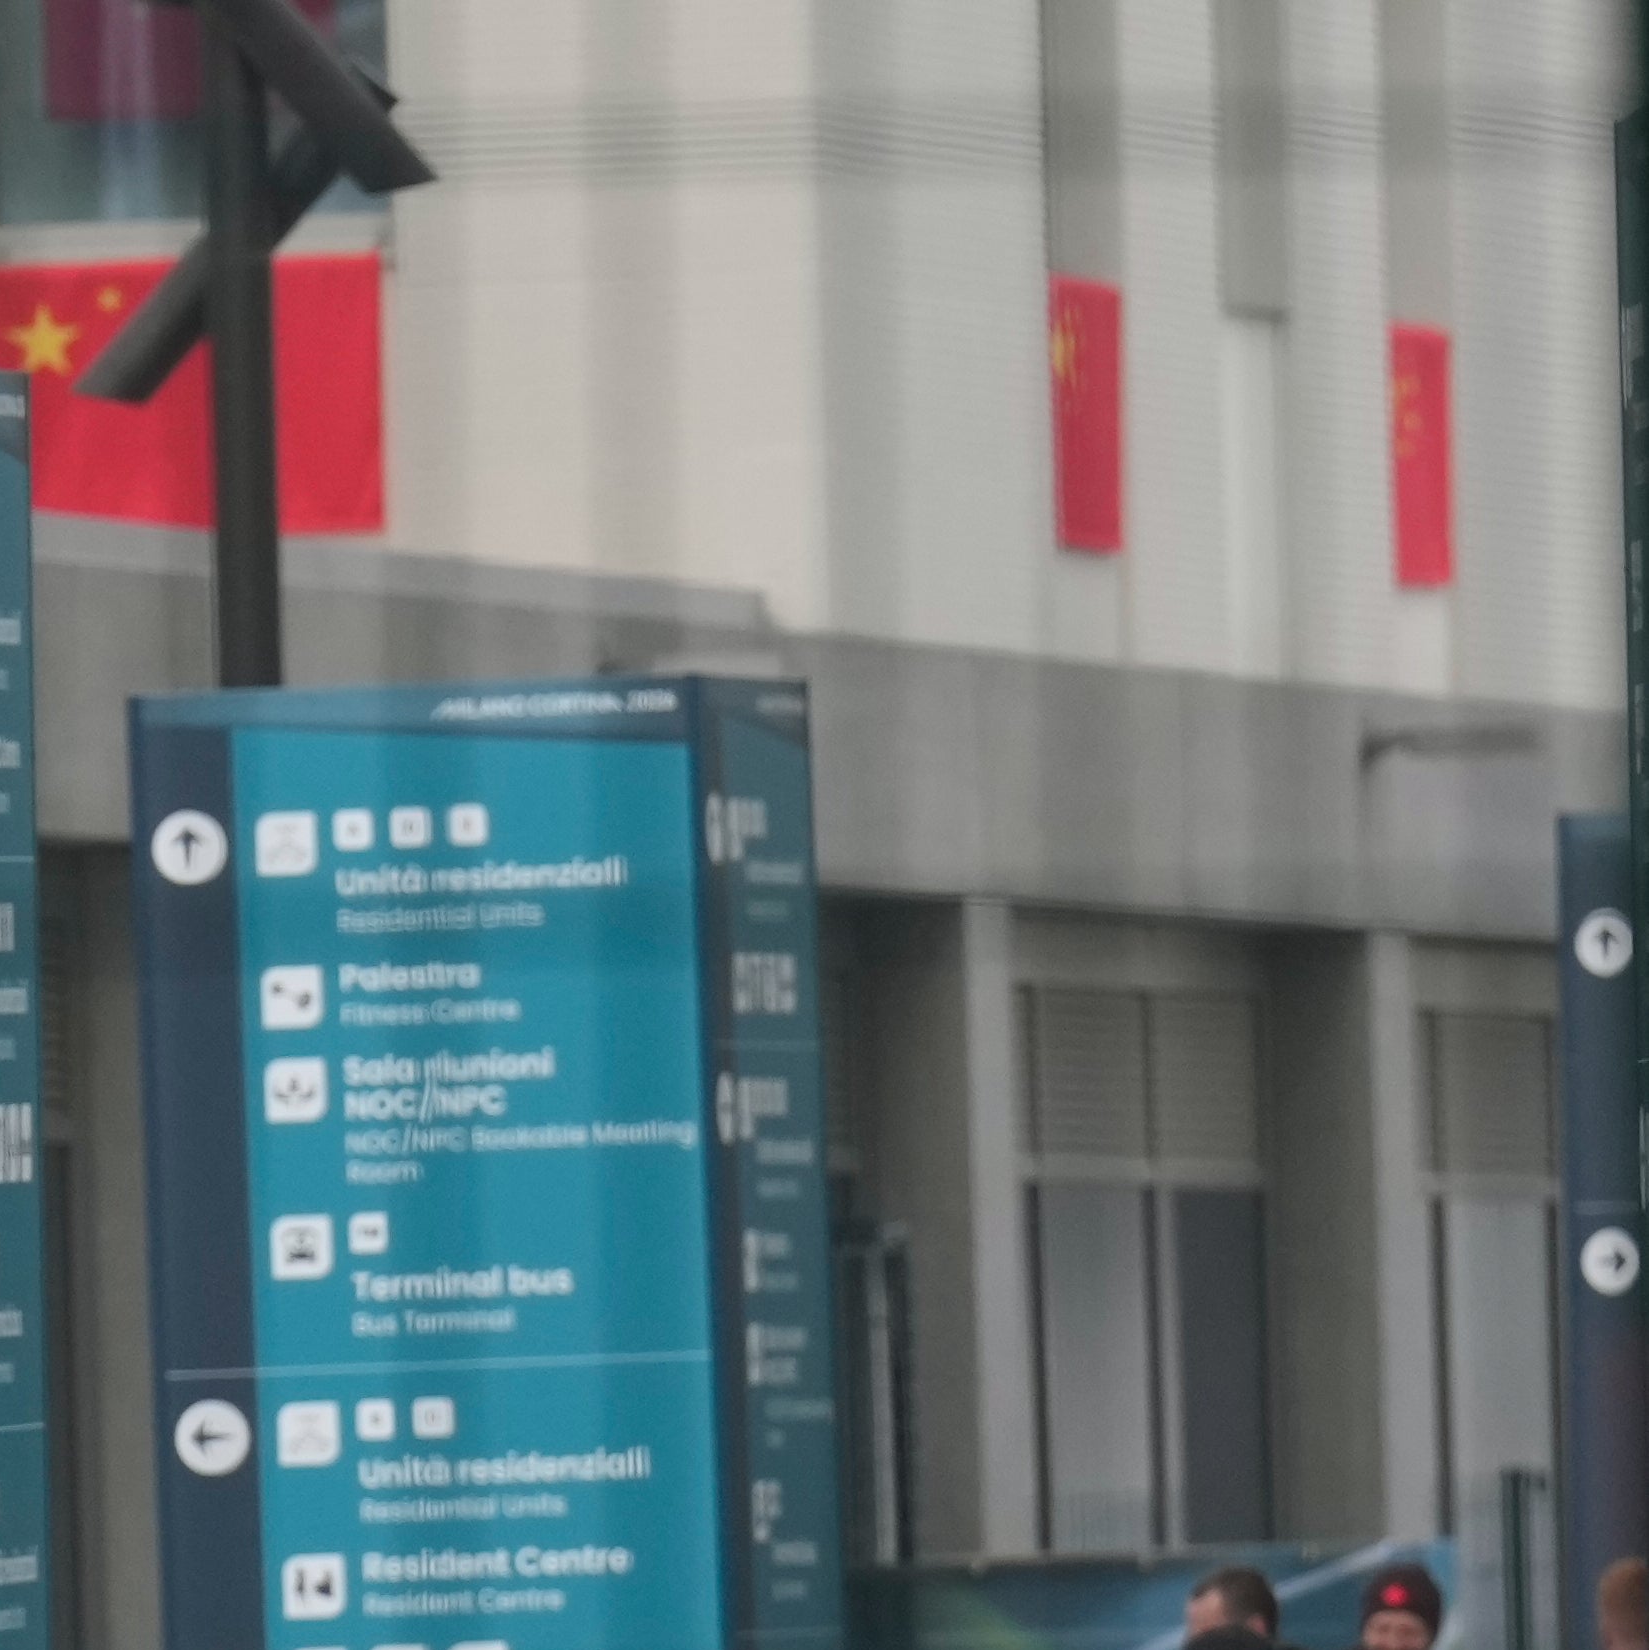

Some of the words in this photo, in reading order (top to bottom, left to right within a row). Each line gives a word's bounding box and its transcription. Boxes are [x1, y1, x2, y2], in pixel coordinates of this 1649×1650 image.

[335, 861, 429, 896] Unità
[433, 855, 627, 890] residenziali
[342, 1051, 415, 1082] Sala
[422, 1045, 555, 1079] riunioni
[343, 1084, 509, 1120] NOC/NPC
[593, 1118, 696, 1149] Meeting
[352, 1265, 500, 1300] Terminal
[507, 1262, 574, 1295] bus
[359, 1454, 450, 1488] Unità
[456, 1445, 651, 1482] residenziali
[361, 1549, 513, 1580] Resident
[519, 1544, 633, 1575] Centre
